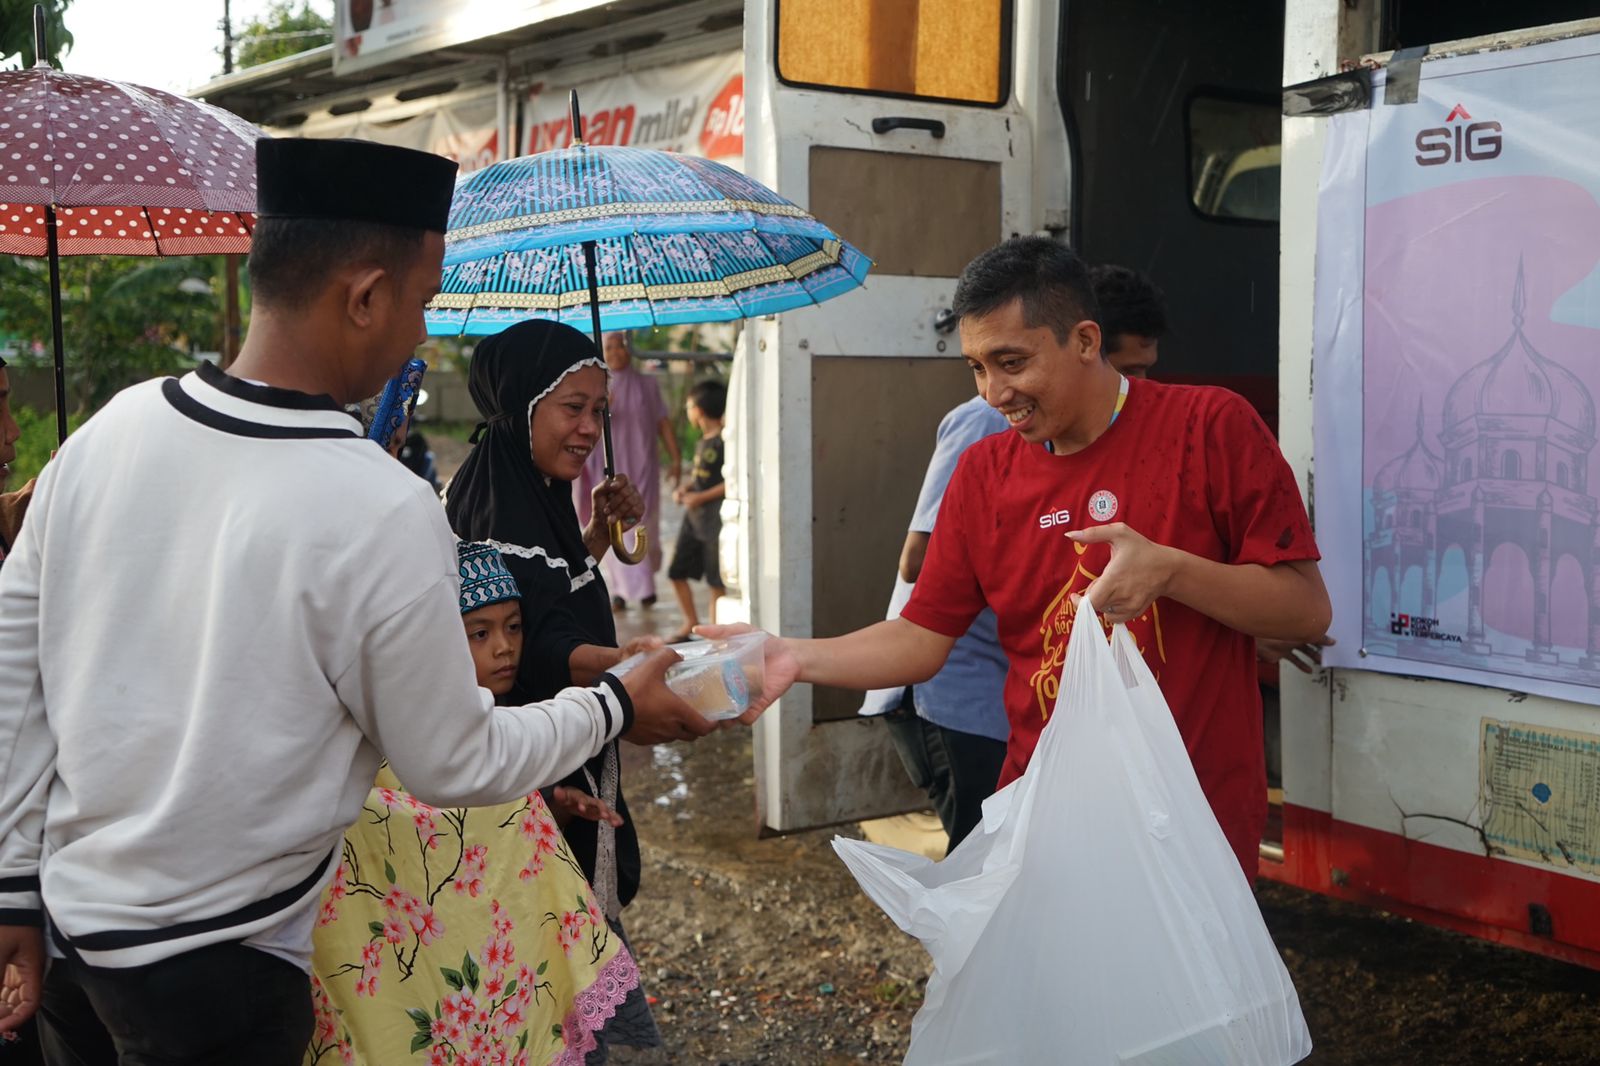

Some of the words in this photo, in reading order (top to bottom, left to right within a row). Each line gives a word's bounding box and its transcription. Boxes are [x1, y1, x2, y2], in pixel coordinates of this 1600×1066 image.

[634, 97, 698, 144] mild
[1415, 121, 1503, 166] SIG
[1039, 509, 1070, 529] SIG
